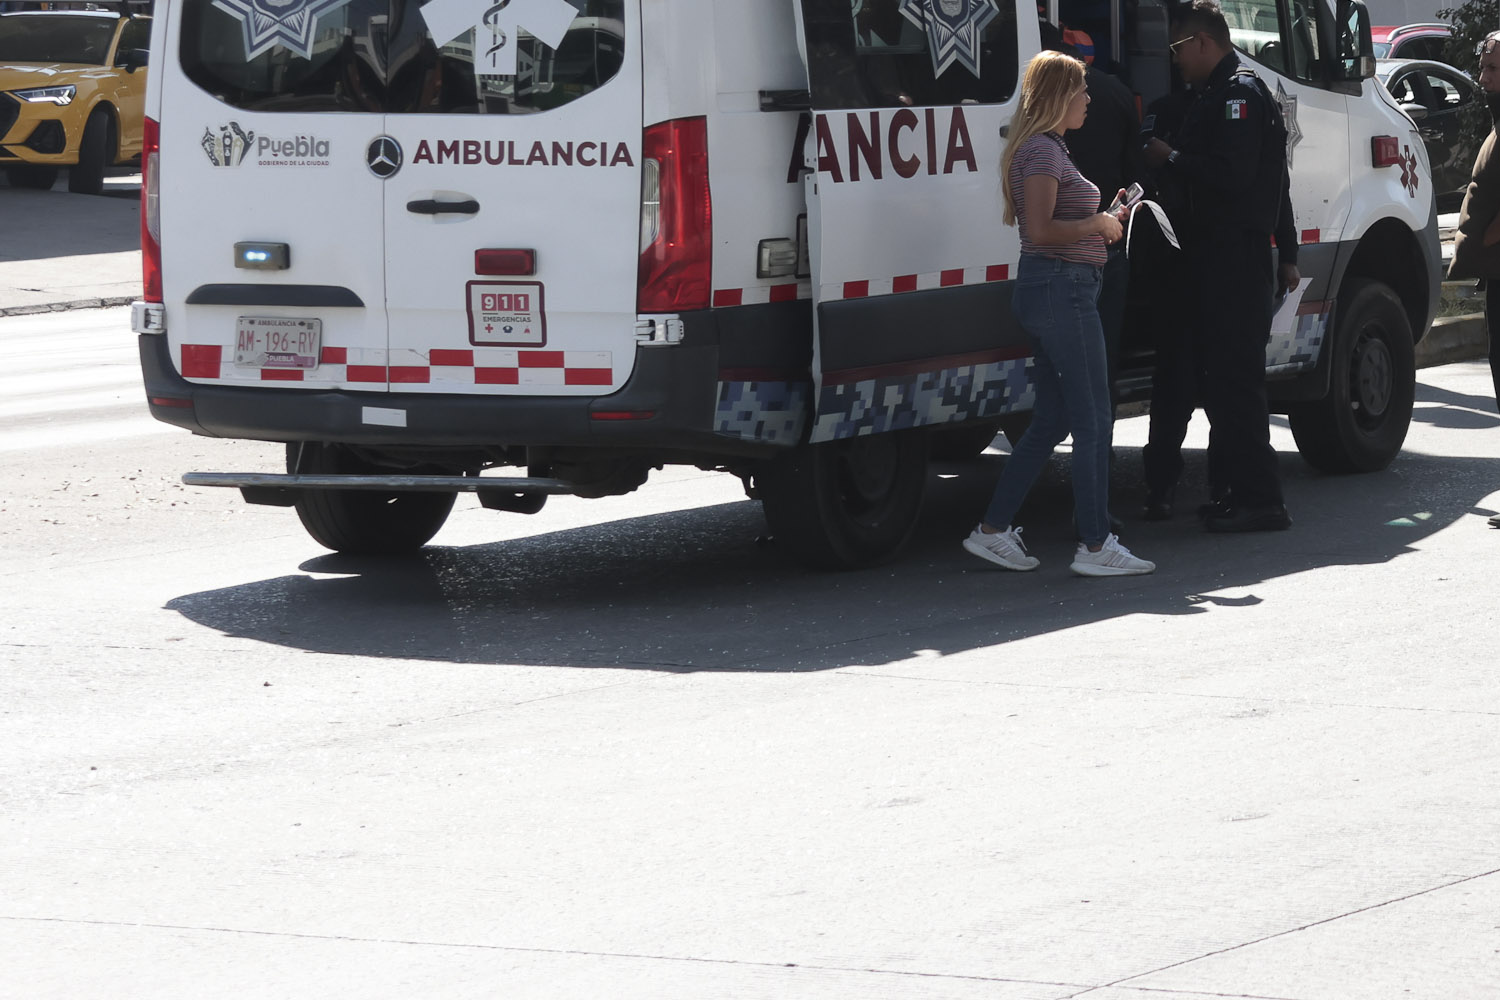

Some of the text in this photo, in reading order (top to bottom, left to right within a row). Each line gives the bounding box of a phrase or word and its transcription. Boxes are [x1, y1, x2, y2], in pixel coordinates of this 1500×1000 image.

[258, 136, 330, 157] Puebla
[412, 139, 634, 167] AMBULANCIA
[484, 295, 525, 310] 911
[238, 330, 316, 352] AM-196-RV
